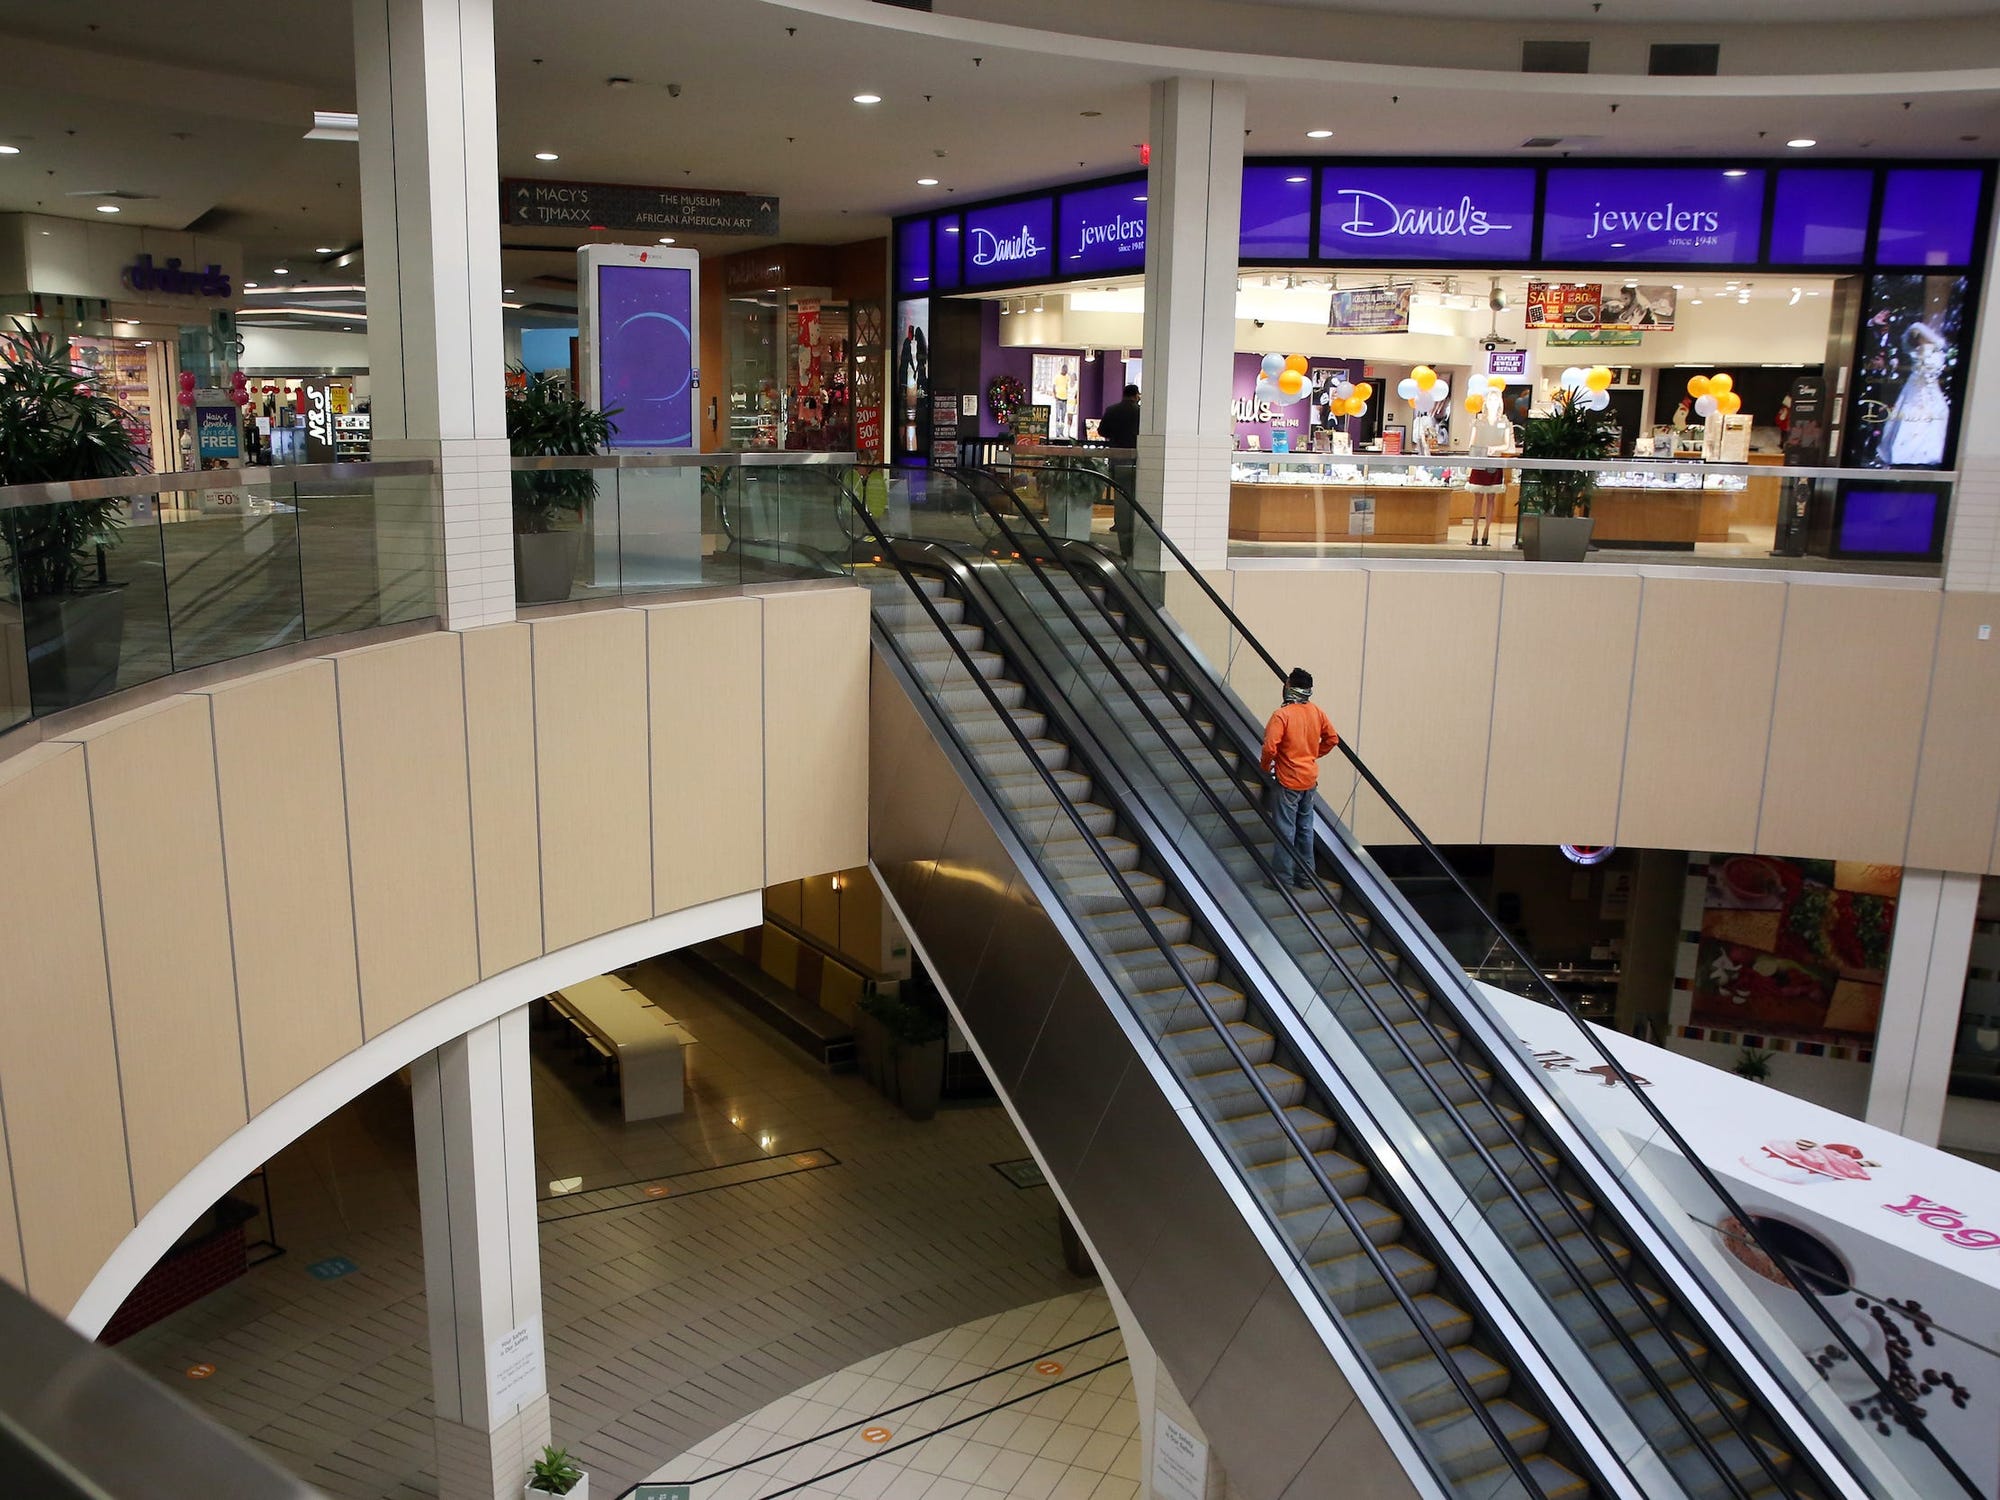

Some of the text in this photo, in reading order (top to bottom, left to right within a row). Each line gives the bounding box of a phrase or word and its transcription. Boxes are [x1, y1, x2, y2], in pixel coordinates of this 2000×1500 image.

[536, 188, 588, 203] MACY'S
[659, 195, 721, 207] THE MUSEUM
[537, 207, 591, 222] TJMAXX
[682, 206, 696, 215] OF
[1338, 189, 1512, 237] Daniel's
[636, 213, 752, 228] AFRICAN AMERICAN ART
[1586, 202, 1719, 239] jewelers
[1078, 215, 1144, 252] jewelers
[1667, 235, 1719, 246] since 1948
[971, 225, 1046, 266] Daniel's
[1529, 292, 1564, 304] SALE!
[856, 410, 869, 423] 20
[860, 424, 880, 440] 50%
[201, 436, 237, 448] FREE
[865, 439, 879, 448] OFF
[217, 494, 233, 505] 50
